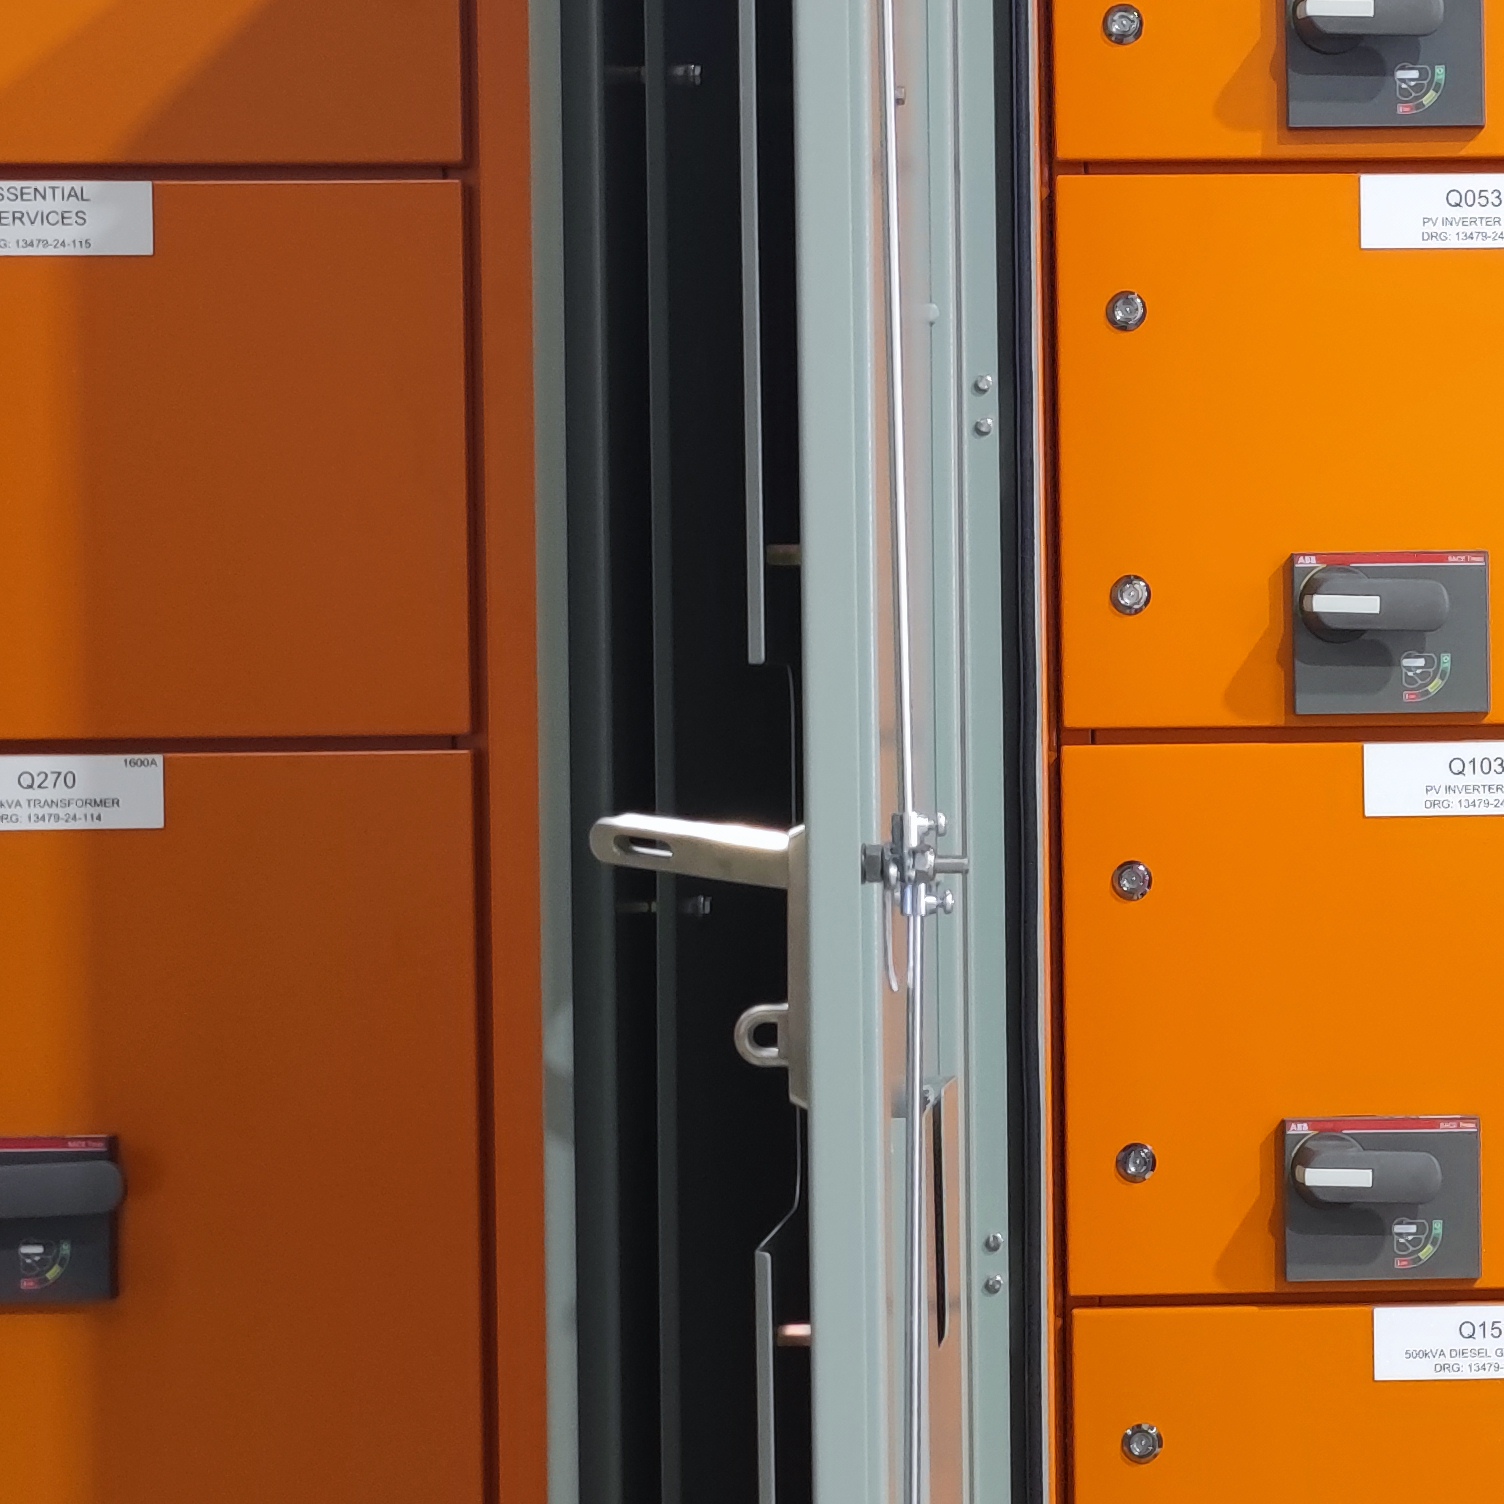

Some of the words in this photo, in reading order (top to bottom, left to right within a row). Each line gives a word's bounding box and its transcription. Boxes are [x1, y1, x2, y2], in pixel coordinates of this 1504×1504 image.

[1445, 189, 1503, 209] Q053
[1422, 217, 1439, 227] PV
[1441, 217, 1502, 227] INVERTER
[1421, 231, 1452, 242] DRG:
[16, 239, 92, 249] 13479-24-115
[1297, 555, 1317, 564] ABB
[123, 758, 158, 768] 1600A
[17, 770, 77, 791] Q270
[1425, 785, 1442, 795] PV
[1444, 784, 1504, 795] INVERTER
[26, 798, 121, 810] TRANSFORMER
[27, 813, 102, 824] 13479-24-114
[1289, 1122, 1309, 1131] ABB
[1404, 1348, 1447, 1360] 500kVA
[1449, 1348, 1492, 1359] DIESEL
[1434, 1363, 1465, 1374] DRG:
